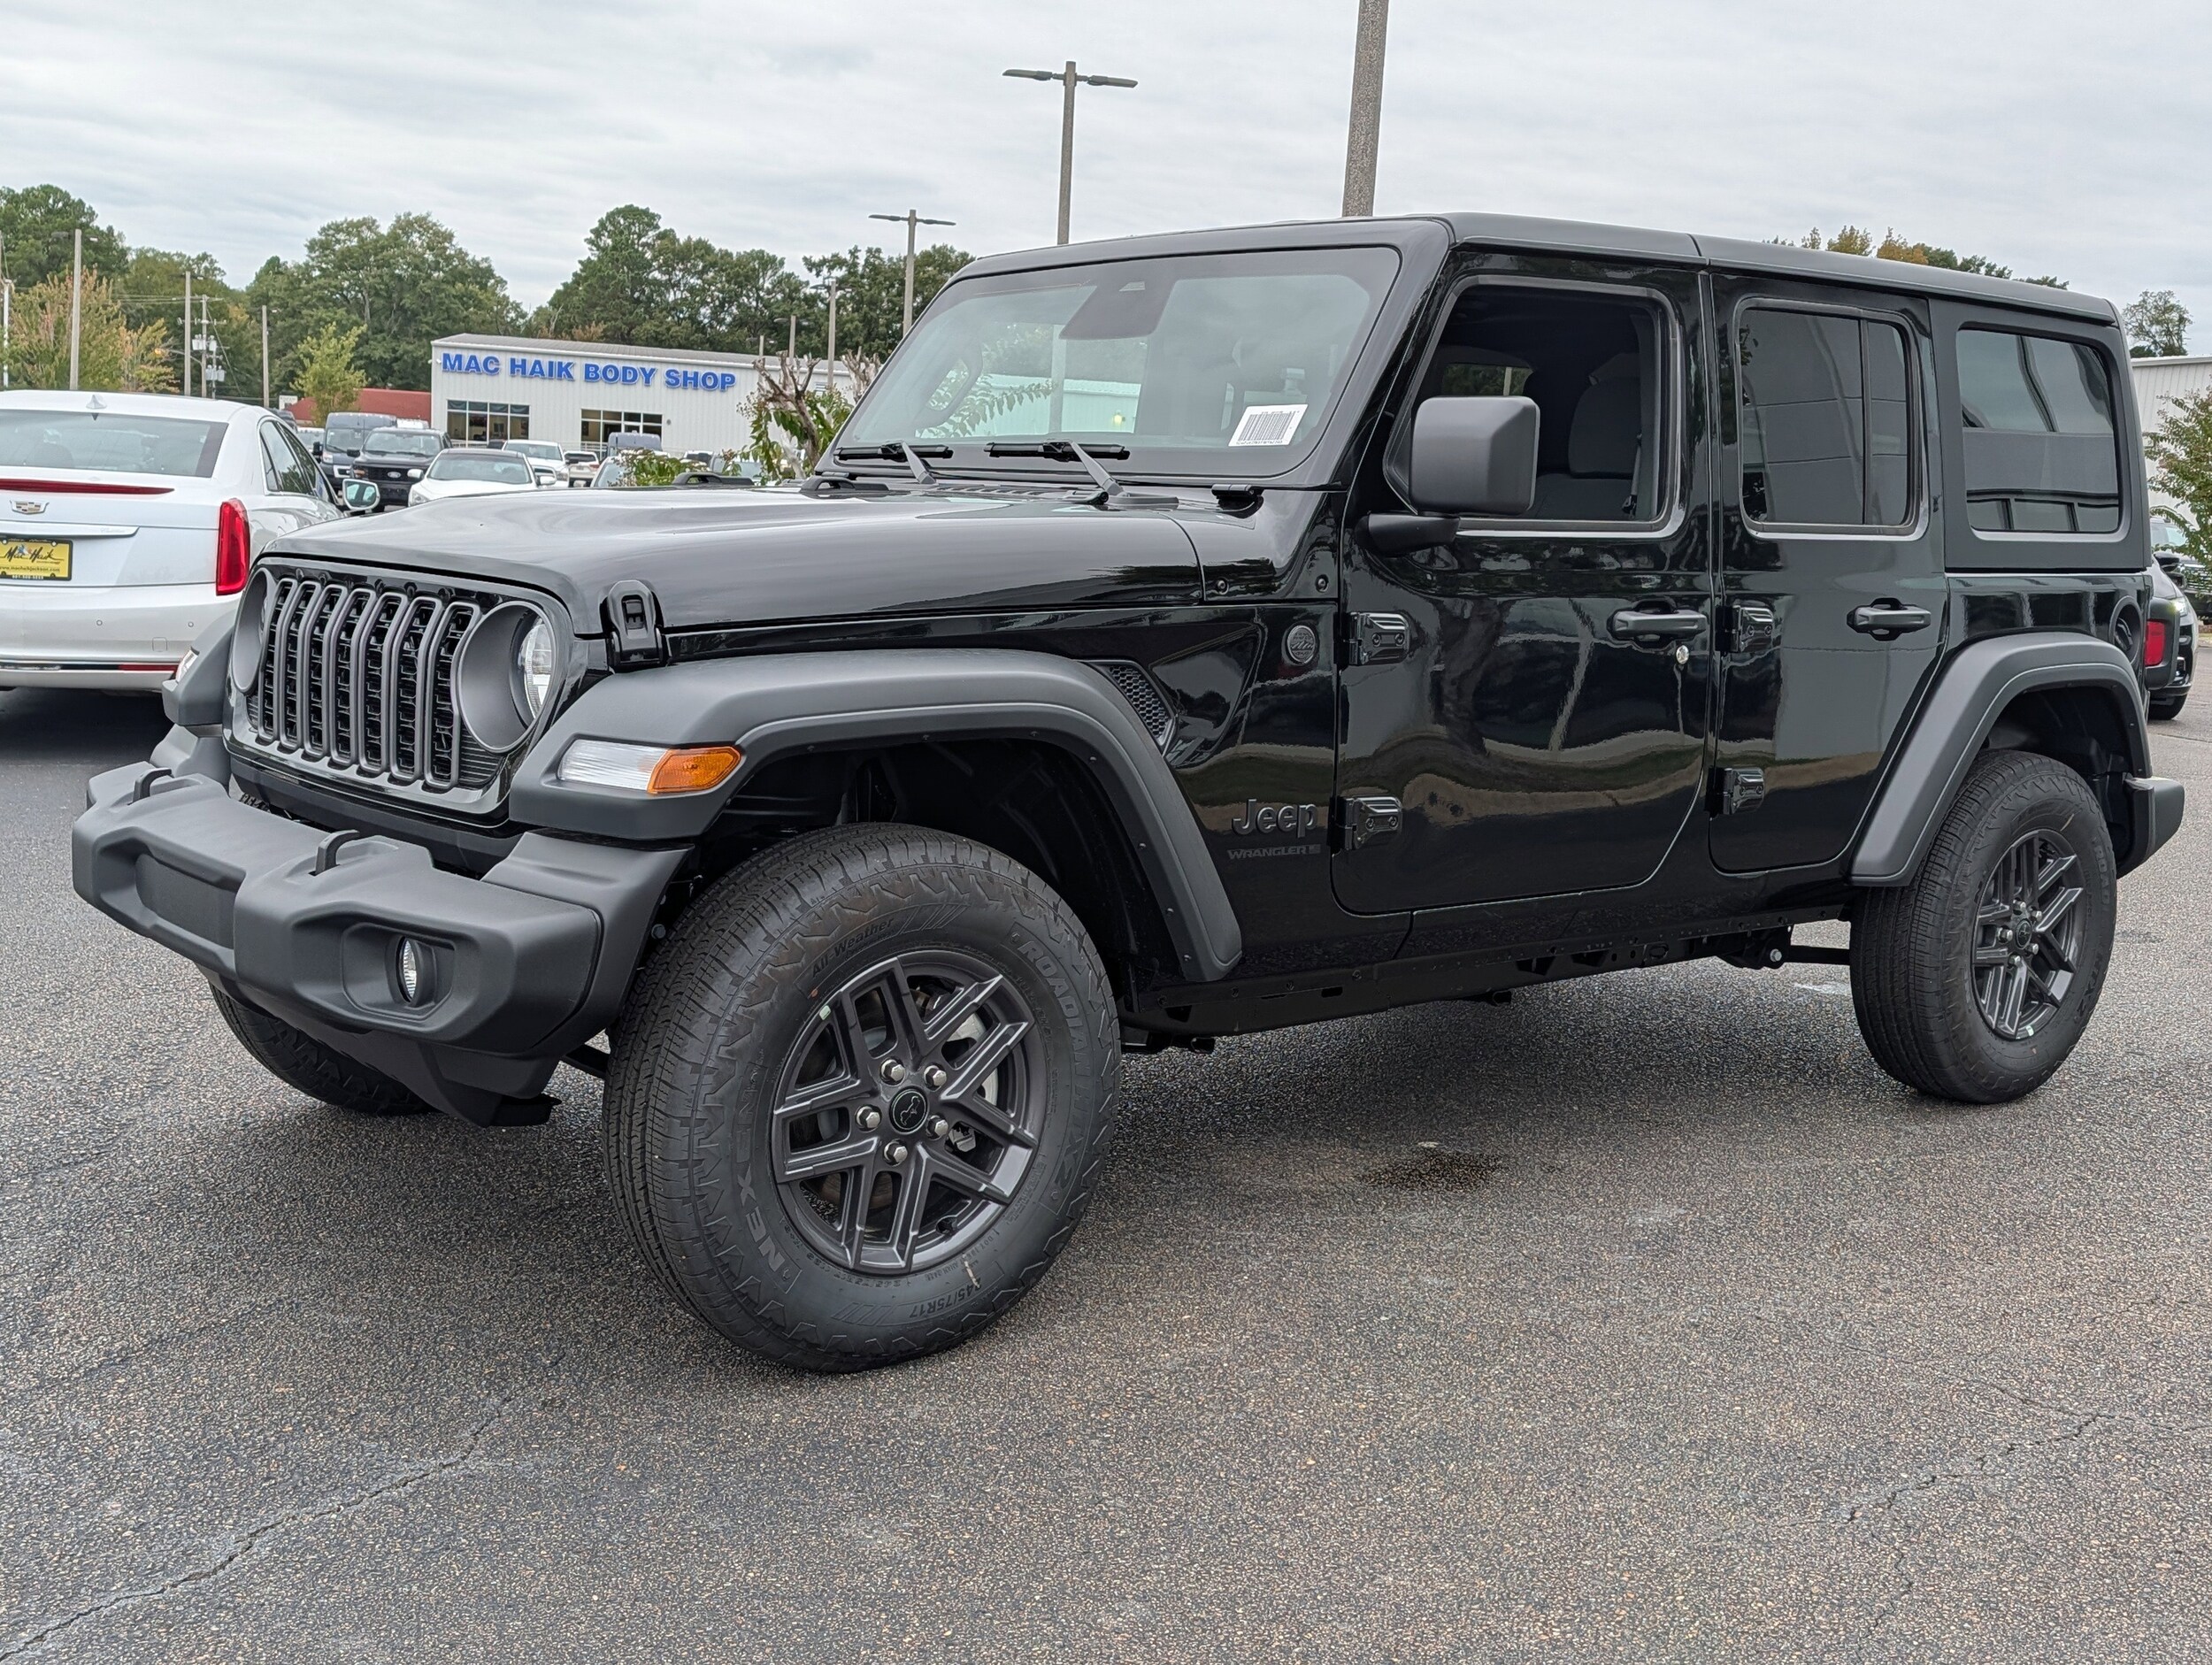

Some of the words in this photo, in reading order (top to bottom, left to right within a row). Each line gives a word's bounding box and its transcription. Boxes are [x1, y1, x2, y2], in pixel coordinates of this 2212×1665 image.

[442, 352, 500, 376] MAC
[510, 357, 575, 381] HAIK
[584, 363, 657, 386] BODY
[664, 368, 736, 392] SHOP
[1231, 798, 1317, 839] Jeep
[1227, 845, 1307, 860] WRANGLER
[811, 917, 895, 978] All-Weather
[1017, 940, 1091, 1078] ROADIAN
[735, 1088, 787, 1273] NEXEN
